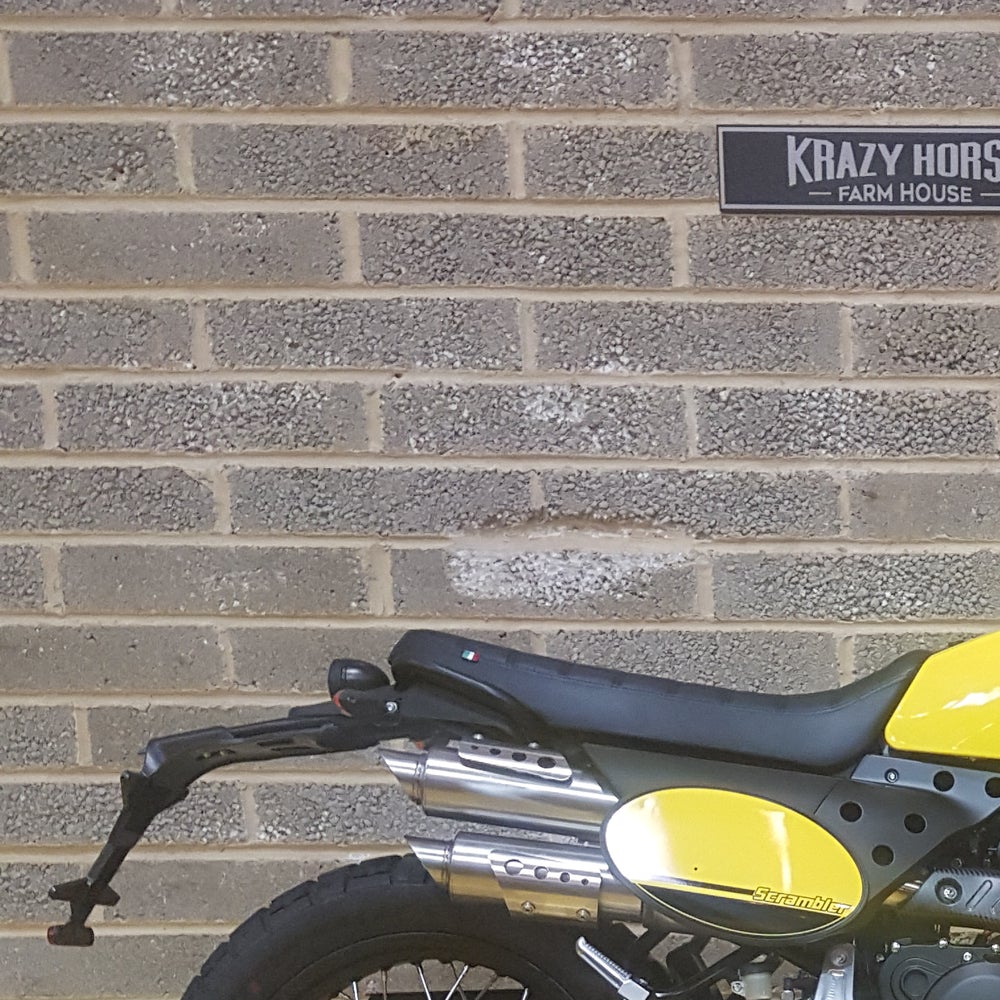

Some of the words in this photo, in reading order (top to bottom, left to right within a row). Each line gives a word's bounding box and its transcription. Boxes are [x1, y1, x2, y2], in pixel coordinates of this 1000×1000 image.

[786, 134, 904, 187] KRAZY
[838, 184, 893, 203] FARM
[900, 182, 973, 203] HOUSE
[752, 886, 851, 915] Scrambler
